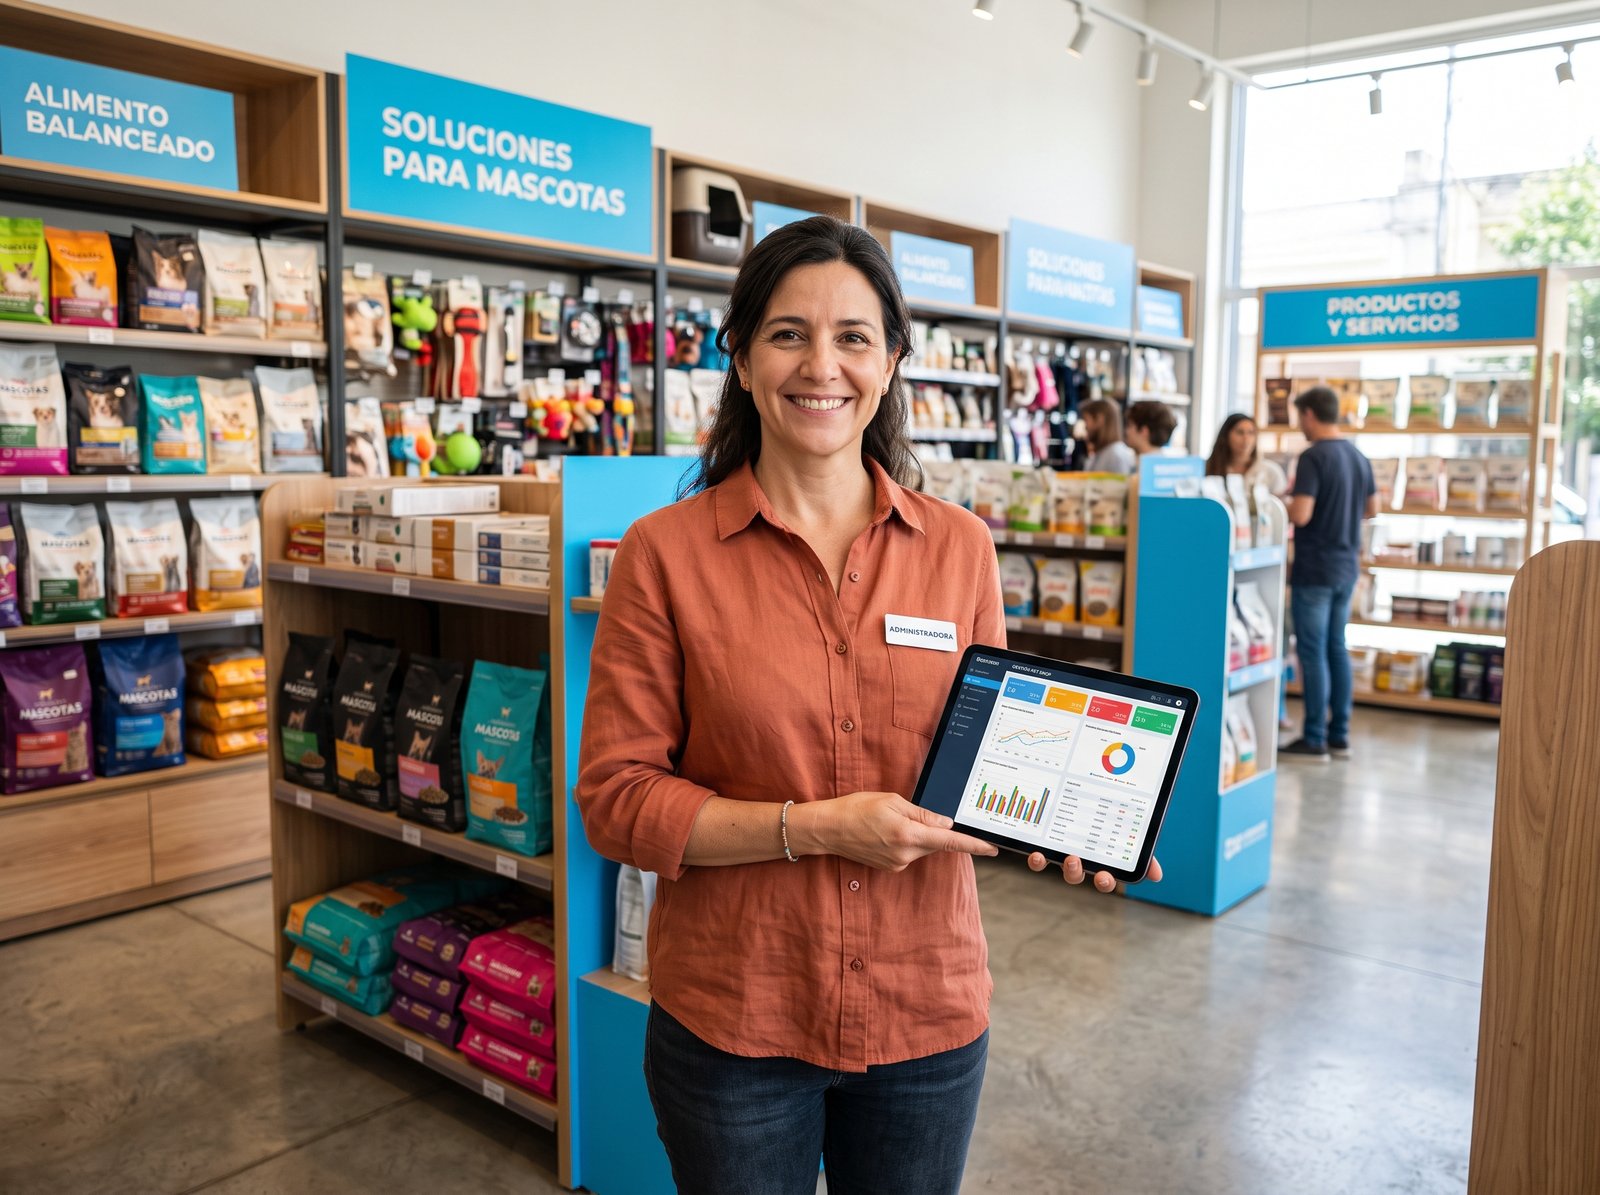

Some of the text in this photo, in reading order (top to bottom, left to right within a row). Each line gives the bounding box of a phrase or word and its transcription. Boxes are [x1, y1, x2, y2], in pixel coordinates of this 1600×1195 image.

[24, 81, 169, 127] ALIMENTO
[26, 109, 215, 163] BALANCEADO
[381, 106, 573, 172] SOLUCIONES
[383, 146, 626, 217] PARA MASCOTAS
[1327, 290, 1461, 316] PRODUCTOS
[1327, 313, 1460, 337] Y SERVICIOS
[889, 626, 954, 640] ADMINISTRADORA
[119, 687, 178, 705] MASCOTAS
[20, 701, 83, 721] MASCOTAS
